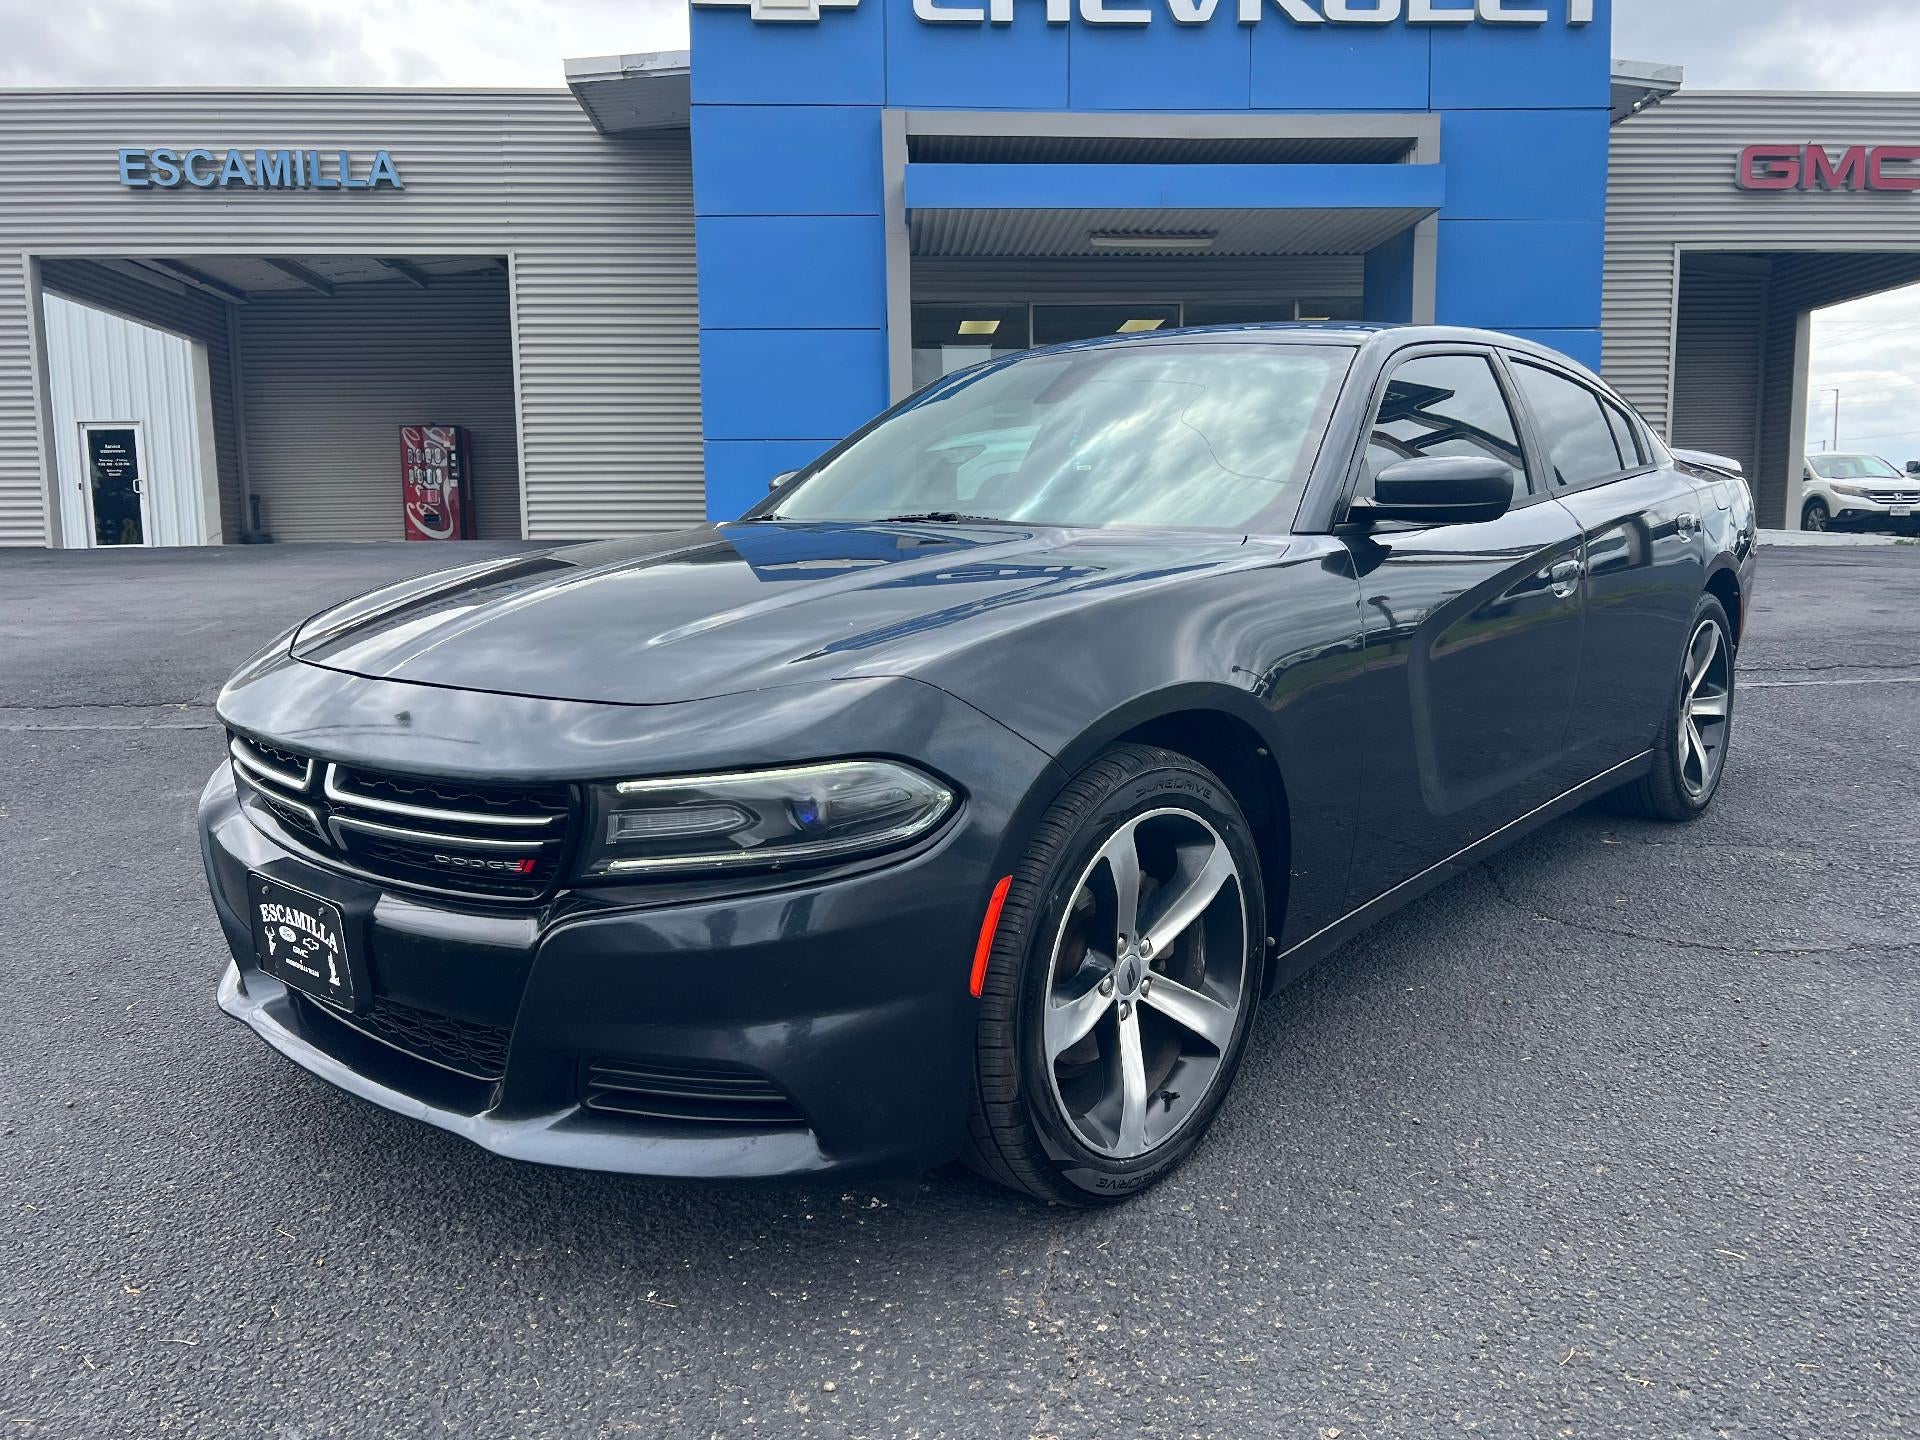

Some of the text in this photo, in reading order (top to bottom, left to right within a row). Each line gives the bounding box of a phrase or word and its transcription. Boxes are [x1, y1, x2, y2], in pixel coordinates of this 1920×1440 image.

[118, 148, 404, 189] ESCAMILLA
[1736, 144, 1920, 191] GMC
[434, 854, 523, 870] DODGE
[259, 903, 339, 954] ESCAMILLA
